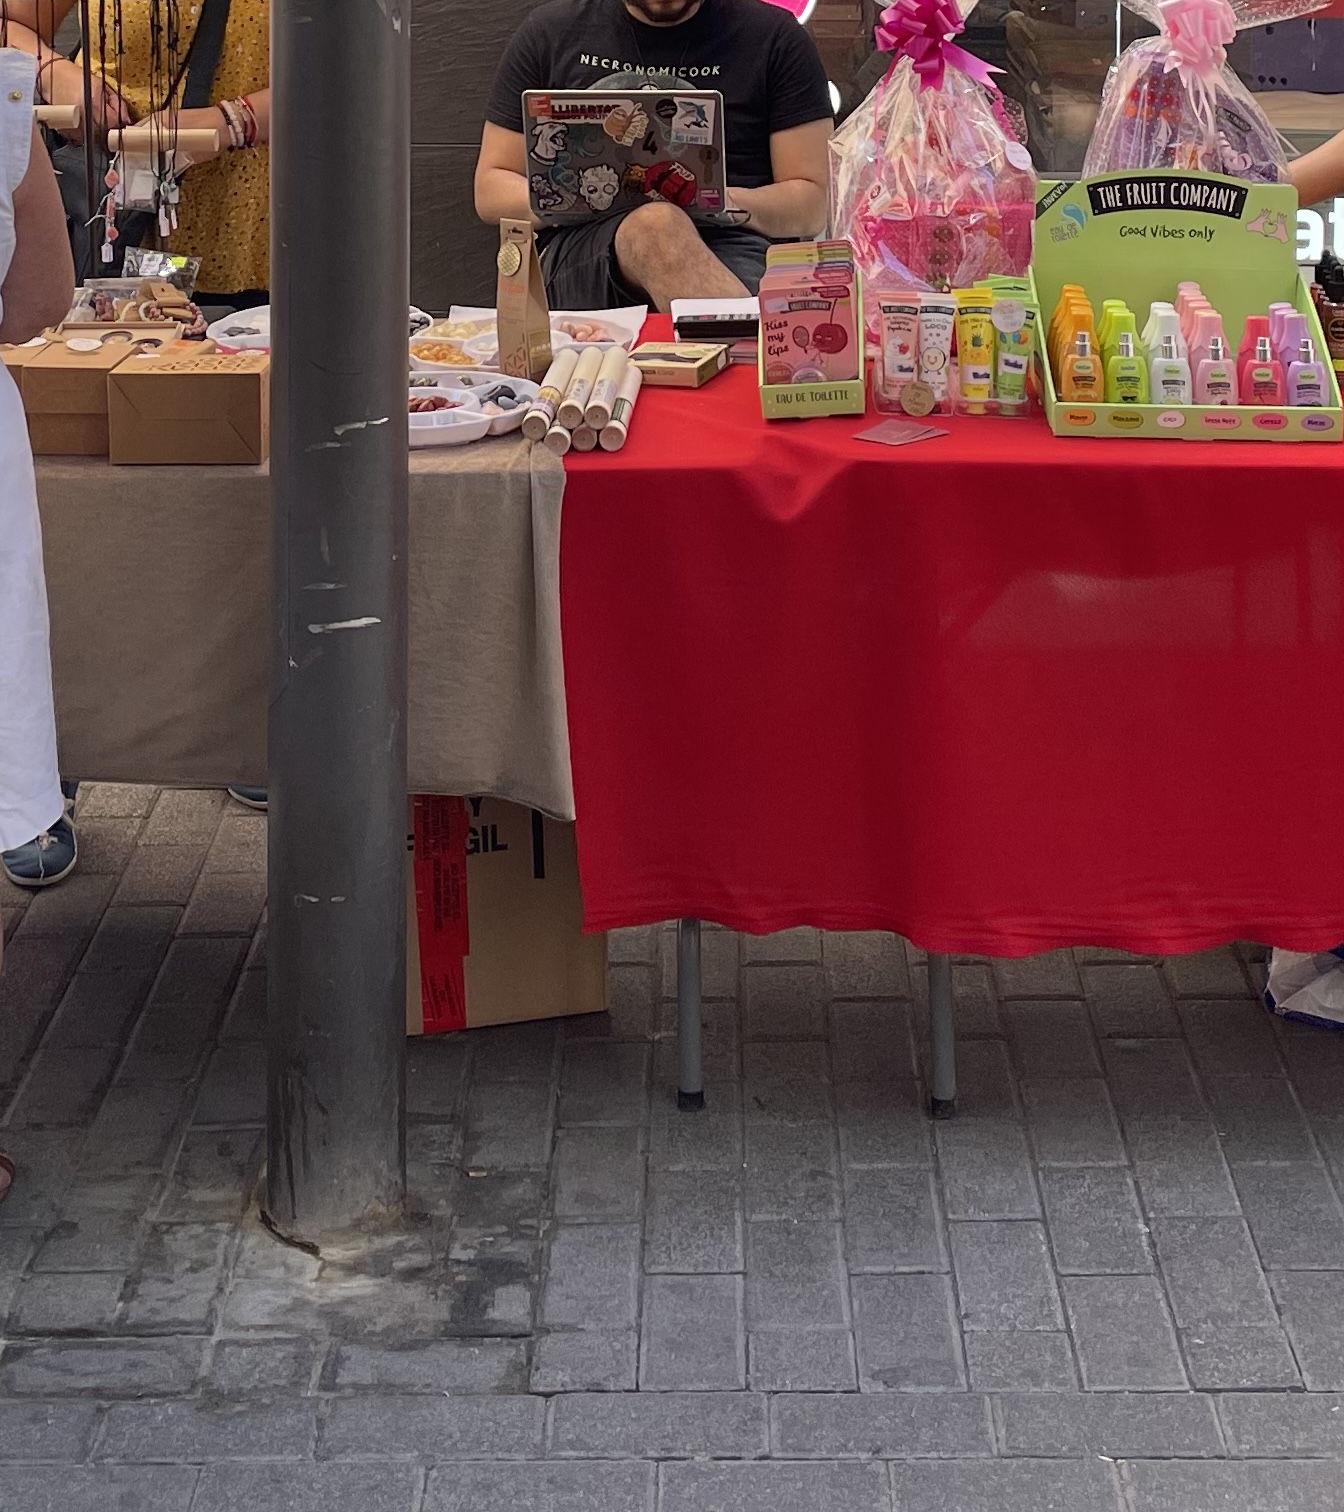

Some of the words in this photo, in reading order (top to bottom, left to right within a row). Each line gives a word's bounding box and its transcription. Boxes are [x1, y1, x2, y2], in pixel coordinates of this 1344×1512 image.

[580, 53, 721, 79] NECRONOMICOOK
[1097, 186, 1120, 209] THE
[1126, 182, 1165, 207] FRUIT
[1170, 182, 1238, 212] COMPANY
[1119, 224, 1146, 238] Good
[1150, 223, 1185, 239] Vibes
[1189, 225, 1215, 242] only
[764, 319, 789, 334] Kiss
[767, 331, 785, 344] my
[767, 343, 790, 357] lips
[775, 392, 793, 404] EAU
[795, 391, 806, 403] DE
[809, 389, 849, 402] TOILETTE
